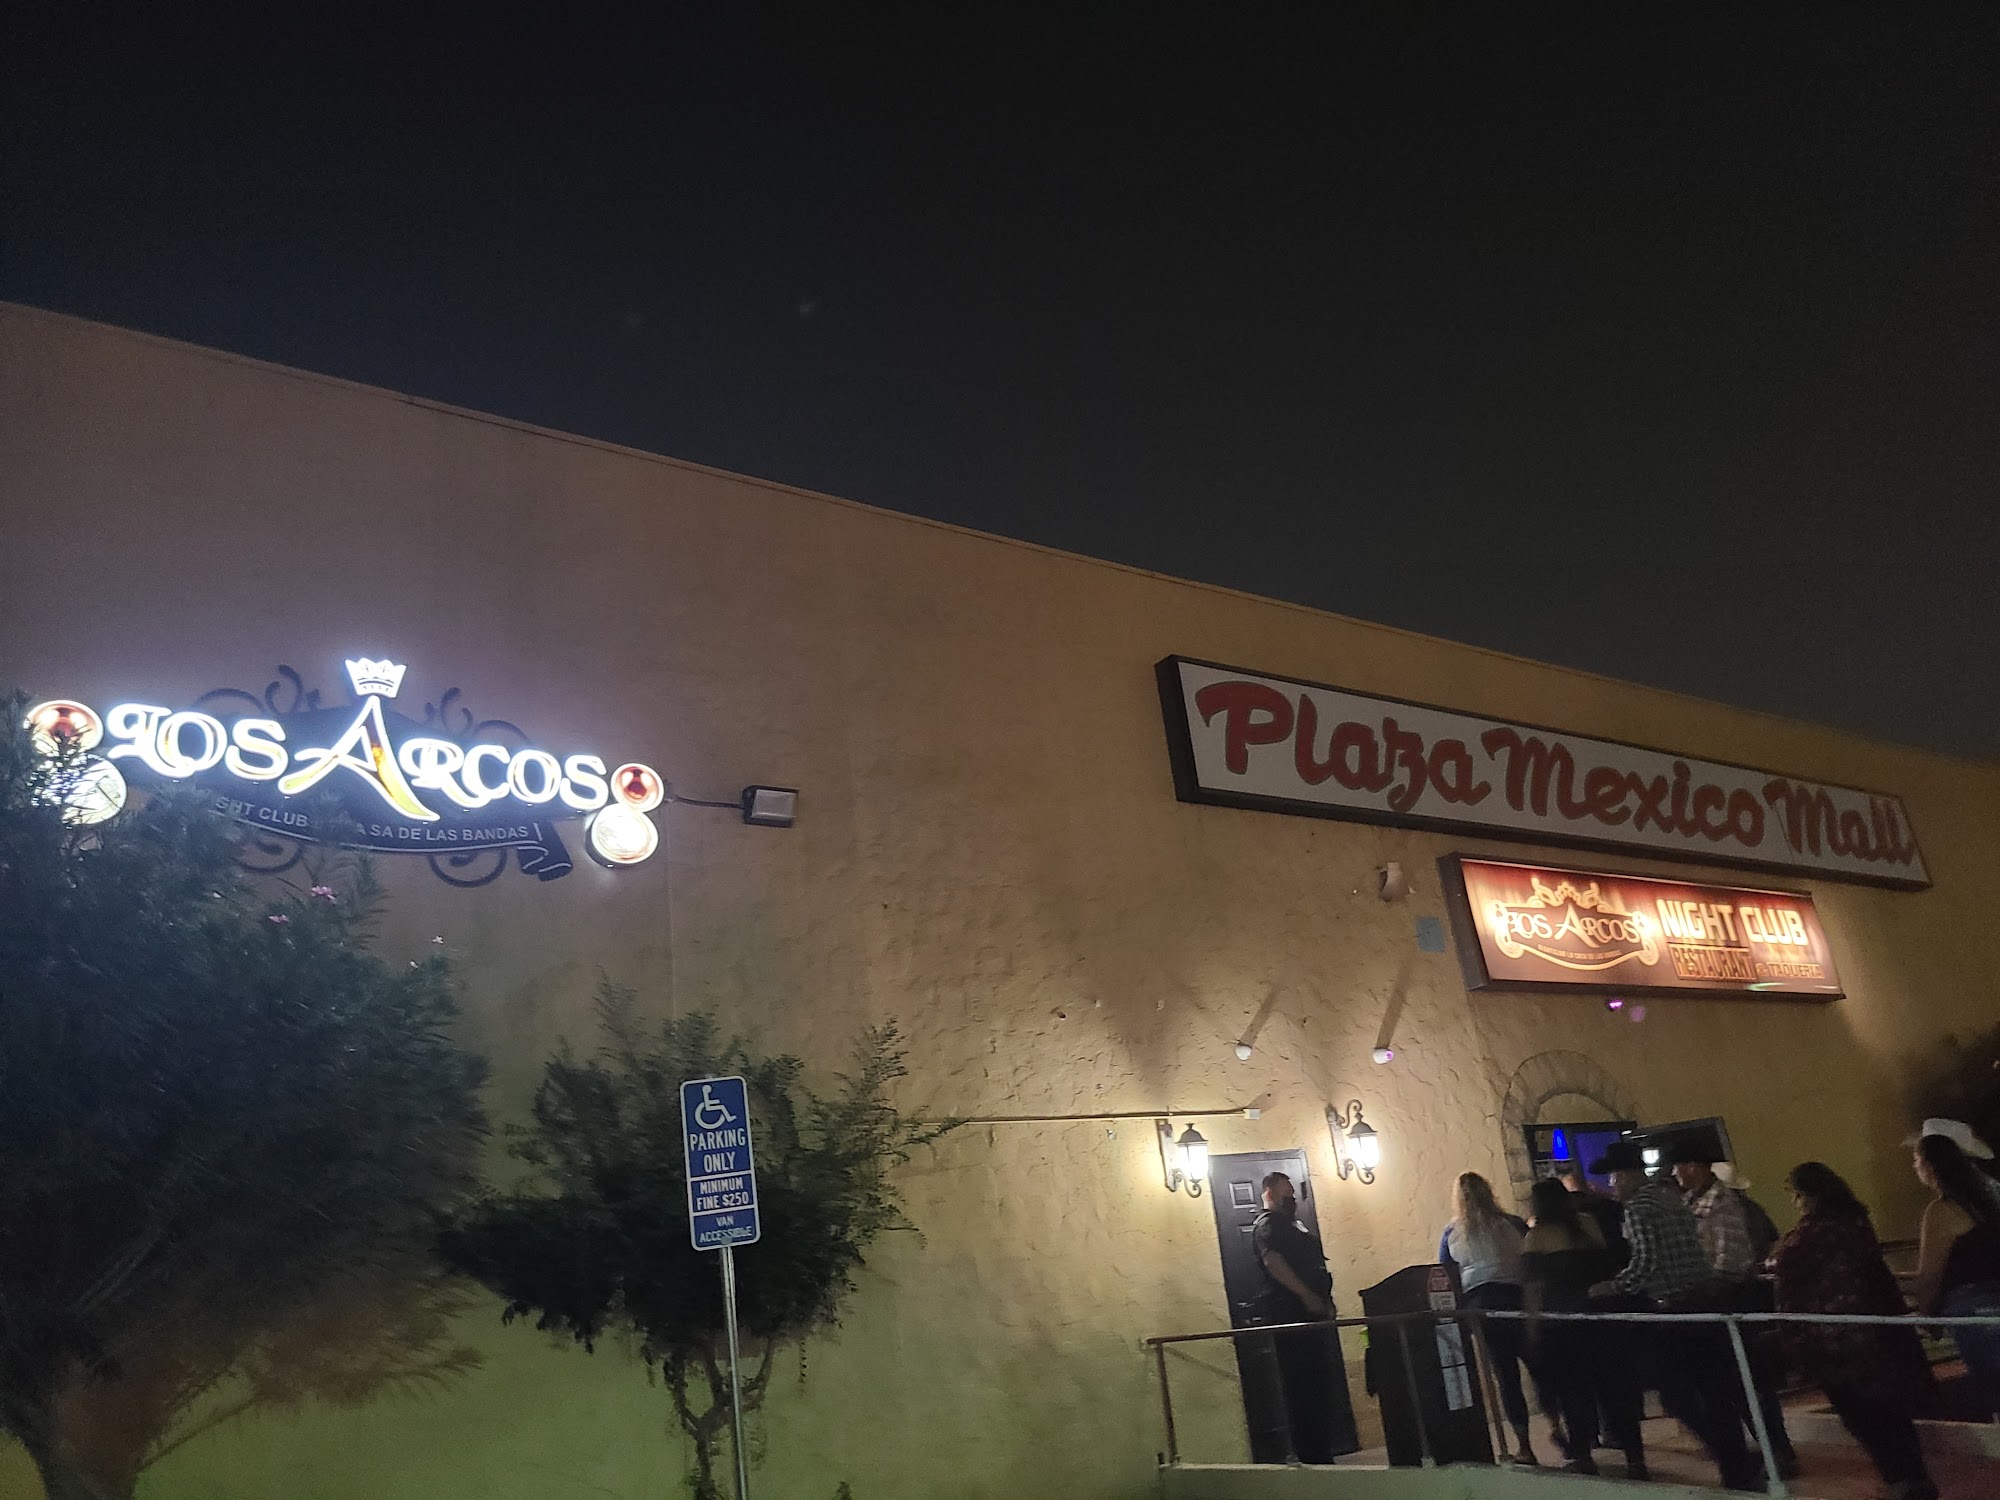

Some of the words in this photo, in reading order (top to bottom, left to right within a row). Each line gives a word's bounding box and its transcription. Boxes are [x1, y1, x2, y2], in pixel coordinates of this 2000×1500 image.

[1194, 681, 1491, 812] Plaza
[1481, 727, 1766, 848] Mexico
[1762, 778, 1914, 866] Mall
[259, 806, 309, 827] CLUB
[399, 827, 421, 840] DE
[426, 829, 457, 842] LAS
[463, 826, 529, 841] BANDAS
[1656, 899, 1738, 942] NIGHT
[1739, 906, 1809, 946] CLUB
[1672, 945, 1756, 980] RESTAURANT
[689, 1128, 746, 1151] PARKING
[704, 1151, 736, 1173] ONLY
[700, 1177, 744, 1195] MINIMUM
[696, 1194, 721, 1210] FINE
[722, 1191, 750, 1207] $250
[716, 1215, 734, 1227] VAN
